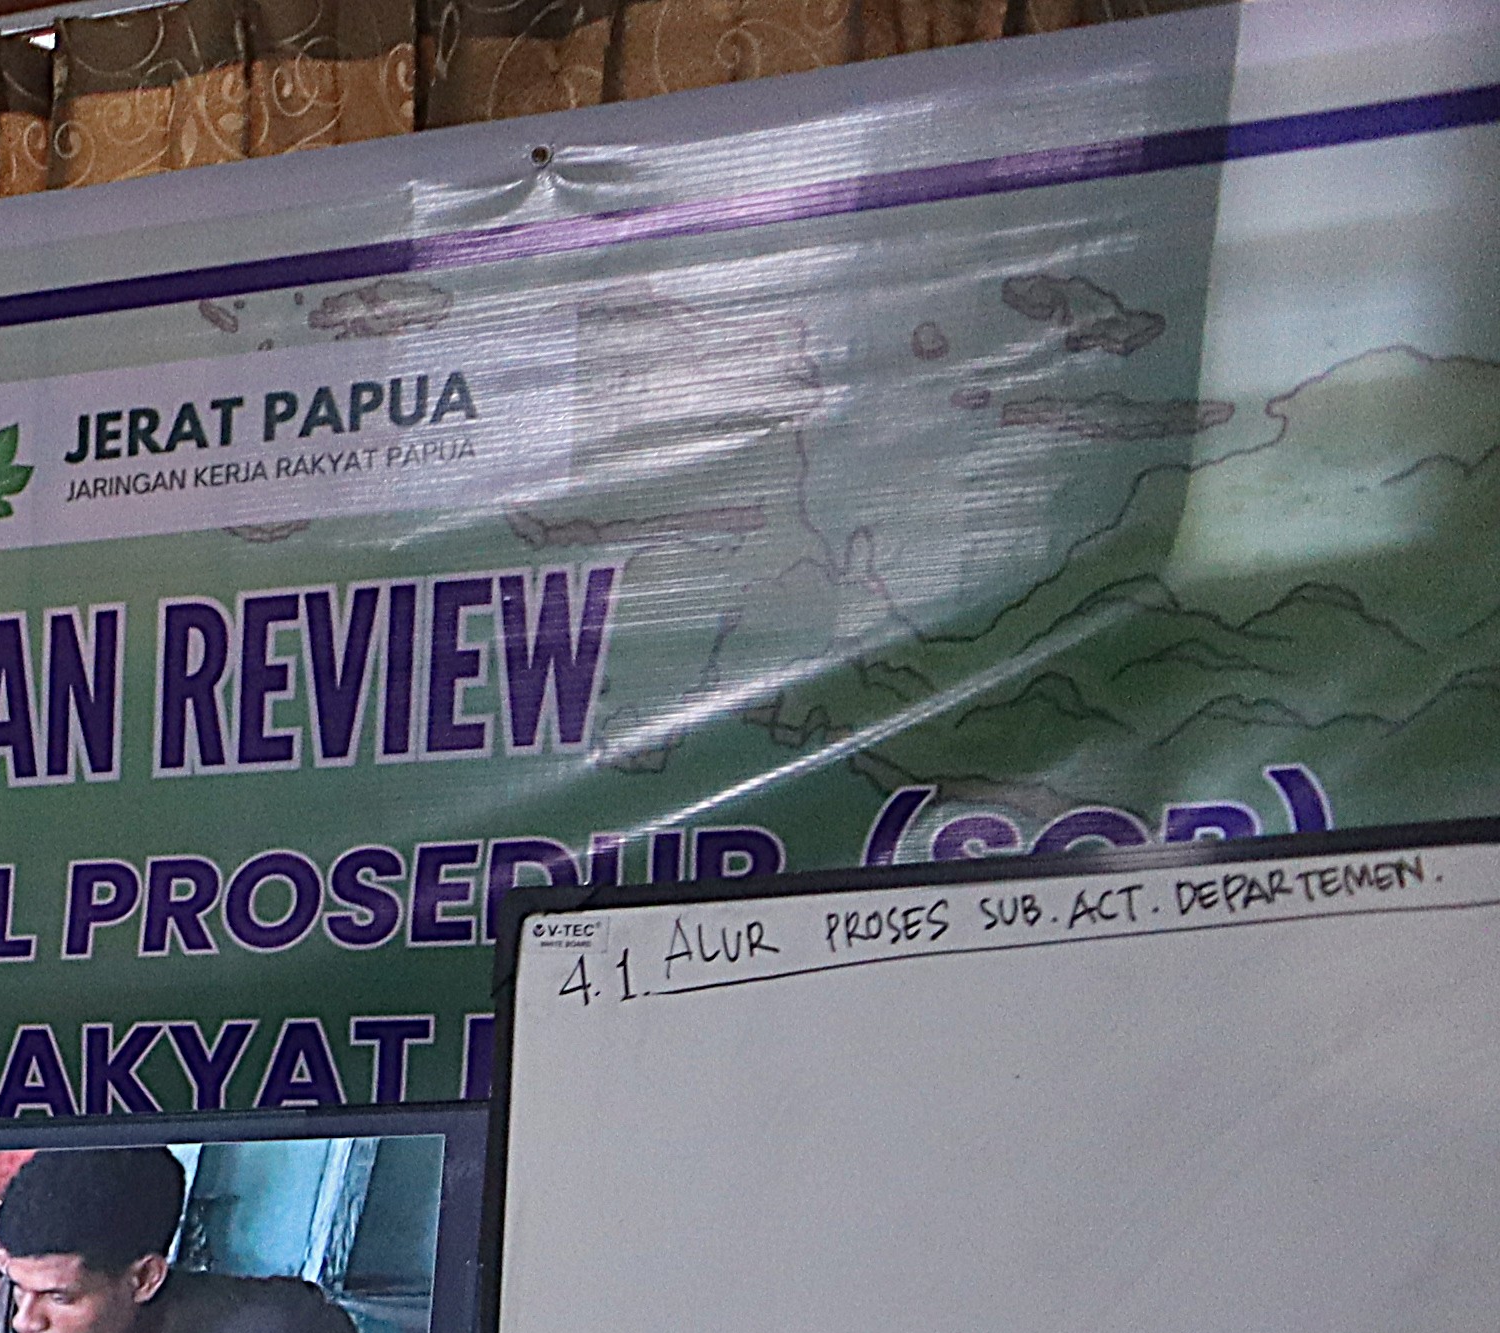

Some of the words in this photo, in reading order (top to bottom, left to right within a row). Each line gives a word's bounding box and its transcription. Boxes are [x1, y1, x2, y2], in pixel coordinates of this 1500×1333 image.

[64, 397, 244, 463] JERAT
[263, 372, 477, 442] PAPUA
[66, 468, 186, 502] JARINGAN
[194, 459, 267, 488] KERJA
[276, 450, 375, 479] RAKYAT
[386, 439, 475, 468] PAPUA
[153, 559, 624, 777] REVIEW
[665, 914, 780, 981] ALUR
[826, 899, 949, 953] PROSES
